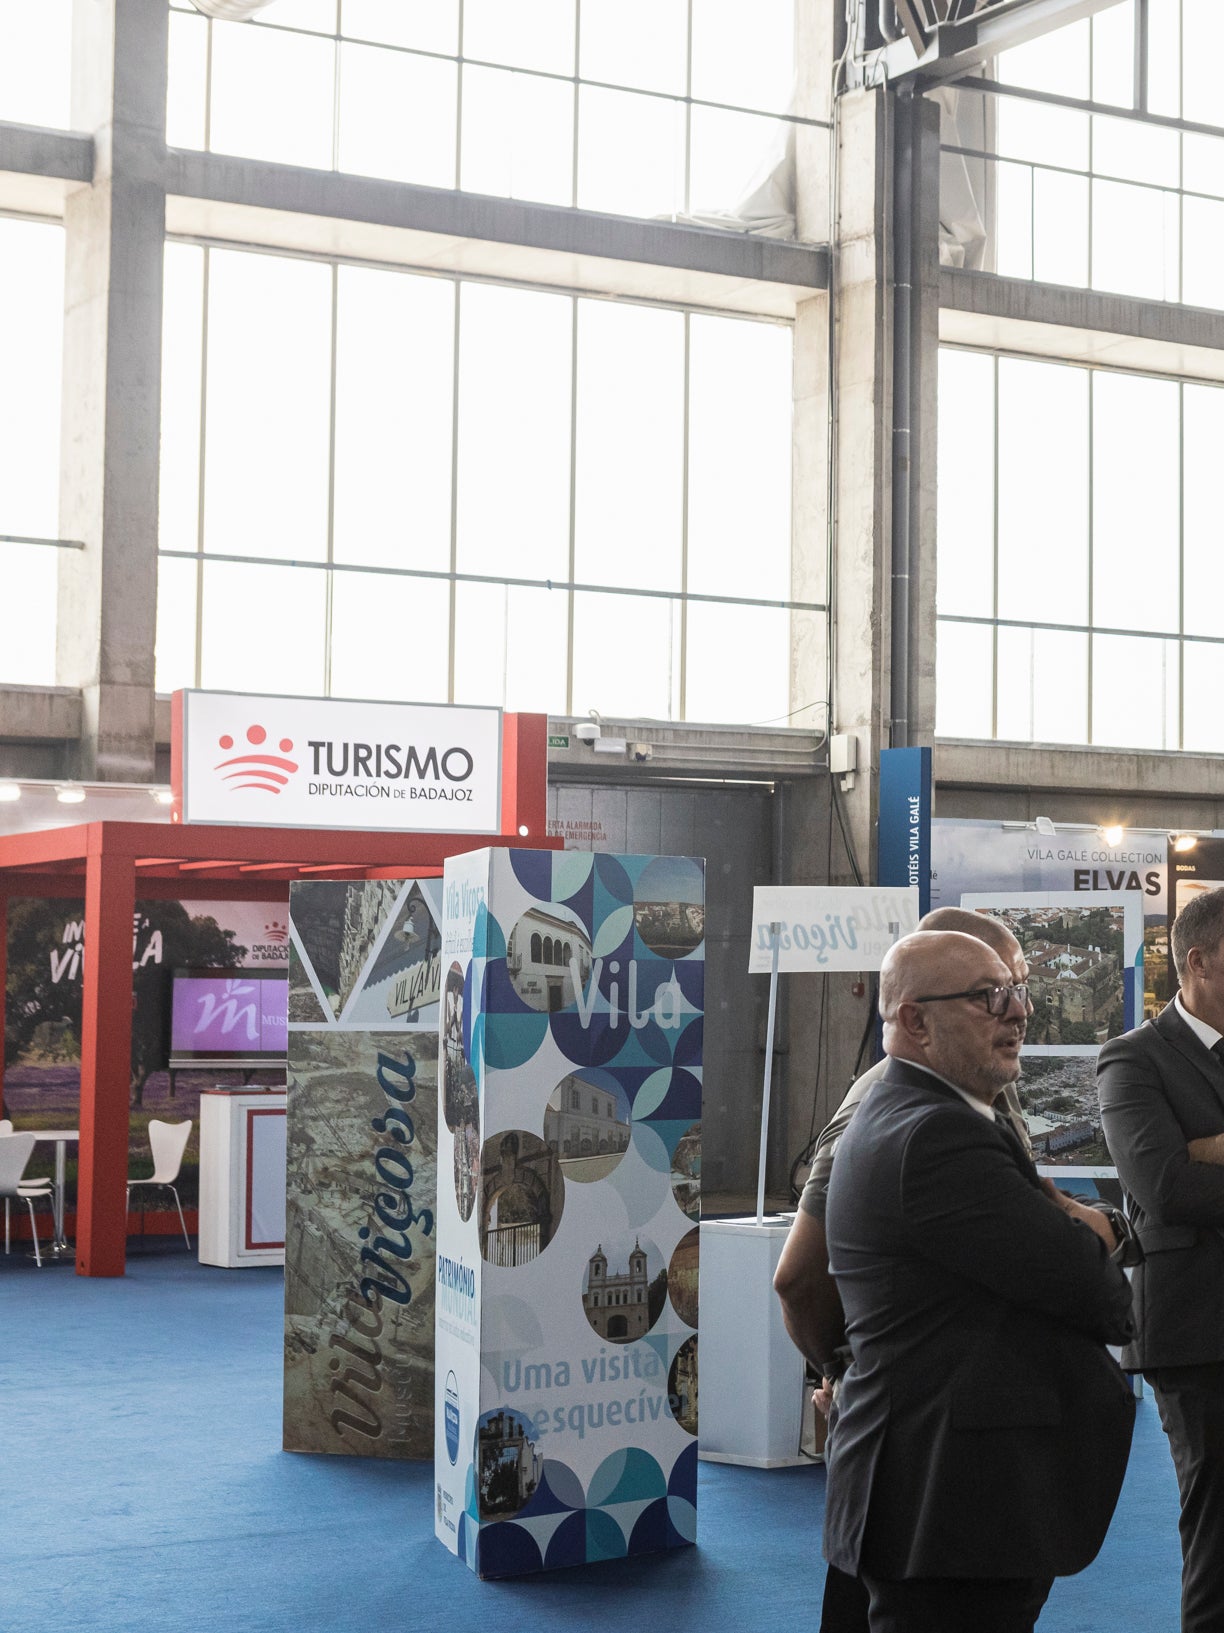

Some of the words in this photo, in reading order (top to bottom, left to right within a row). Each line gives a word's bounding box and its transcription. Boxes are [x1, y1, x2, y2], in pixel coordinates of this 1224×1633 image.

[308, 741, 474, 782] TURISMO
[308, 781, 391, 798] DIPUTACIÓN
[410, 787, 473, 802] BADAJOZ
[907, 795, 920, 824] GALÉ
[548, 820, 564, 830] ERTA
[565, 820, 602, 831] ALARMADA
[565, 831, 607, 841] EMERGENCIA
[909, 826, 920, 852] VILA
[1027, 848, 1053, 860] VILA
[1091, 851, 1162, 864] COLLECTION
[1073, 869, 1162, 896] ELVAS
[252, 945, 289, 953] DIPUTACI
[261, 952, 289, 960] BADAJ
[568, 957, 681, 1030] Vila
[262, 1014, 287, 1026] MUS
[438, 1254, 475, 1299] PATRIMÓNIO
[503, 1360, 570, 1393] Uma
[581, 1345, 661, 1385] visita
